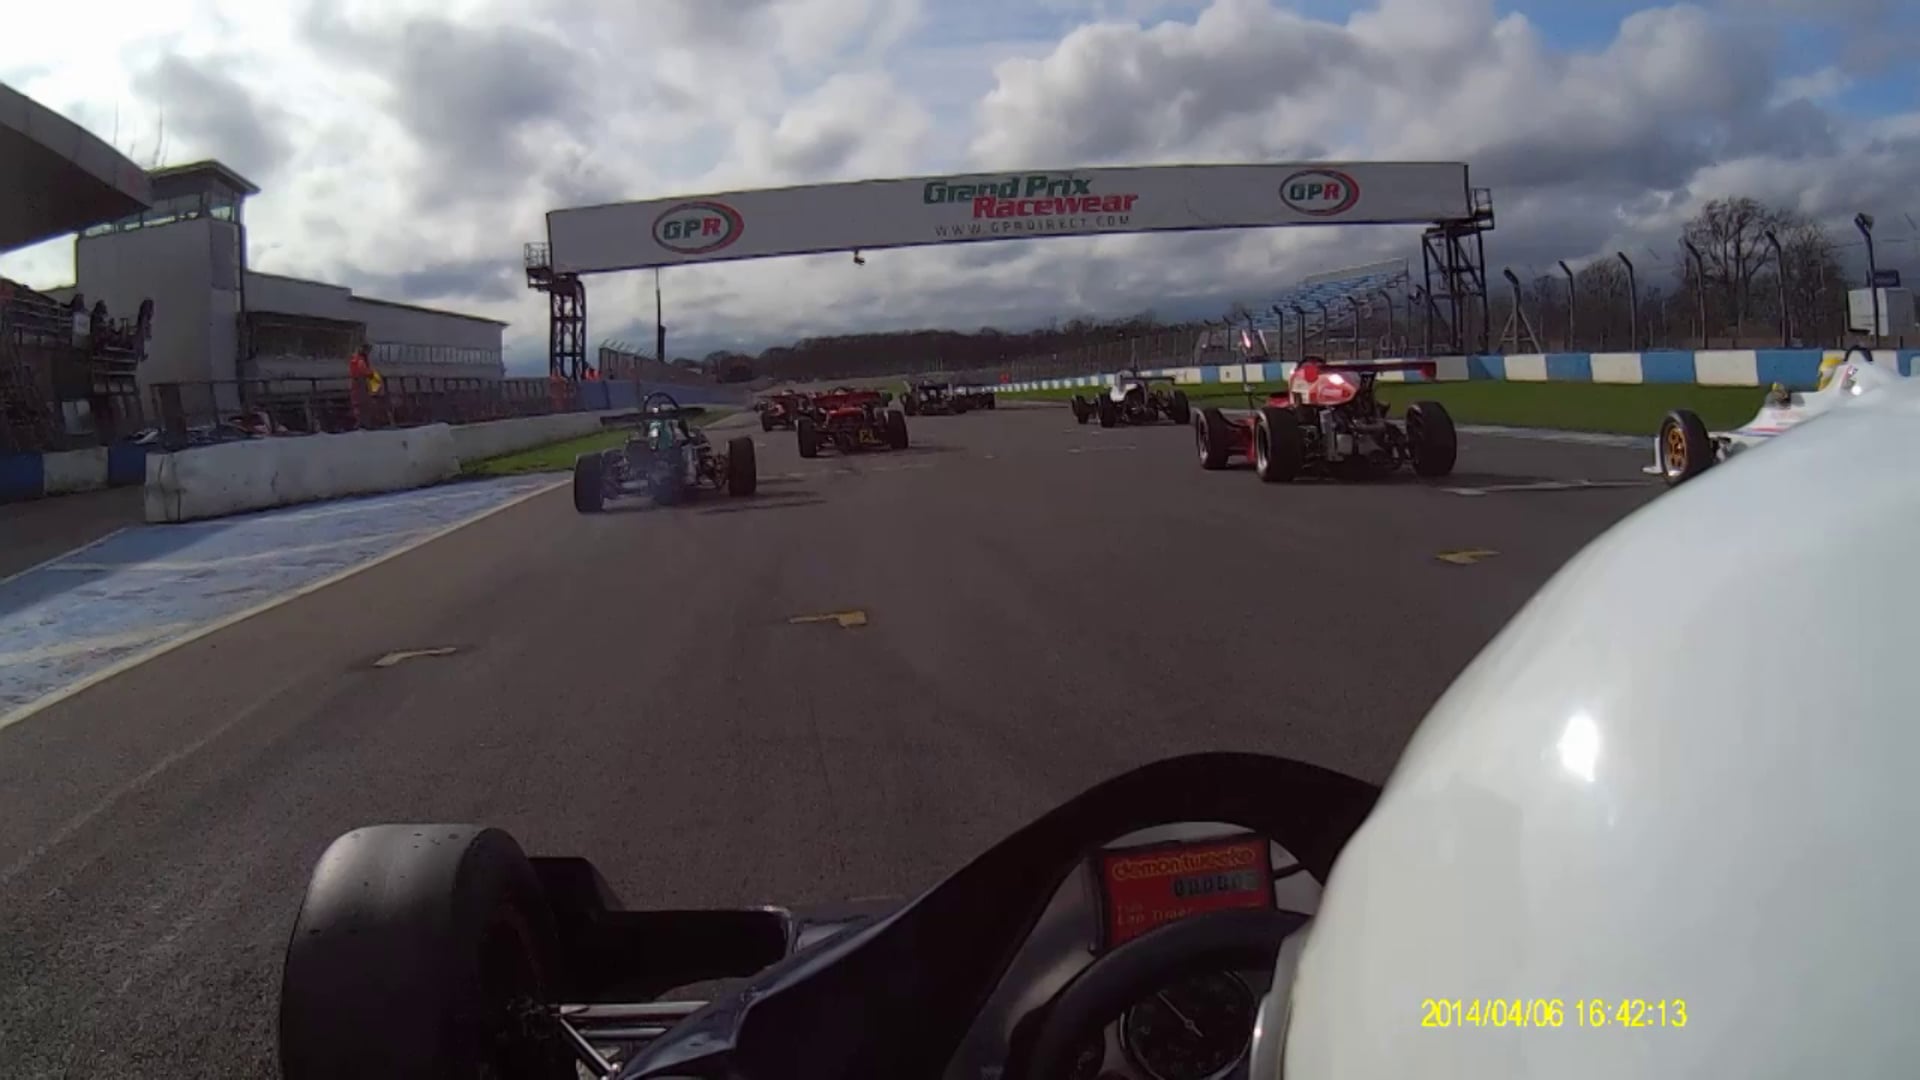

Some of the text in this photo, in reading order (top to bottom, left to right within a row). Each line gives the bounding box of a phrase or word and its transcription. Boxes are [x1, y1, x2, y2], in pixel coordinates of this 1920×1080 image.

[924, 174, 1092, 204] Grand Prix
[1289, 183, 1340, 200] GPR
[972, 193, 1139, 219] Racewear
[664, 217, 721, 240] GPR
